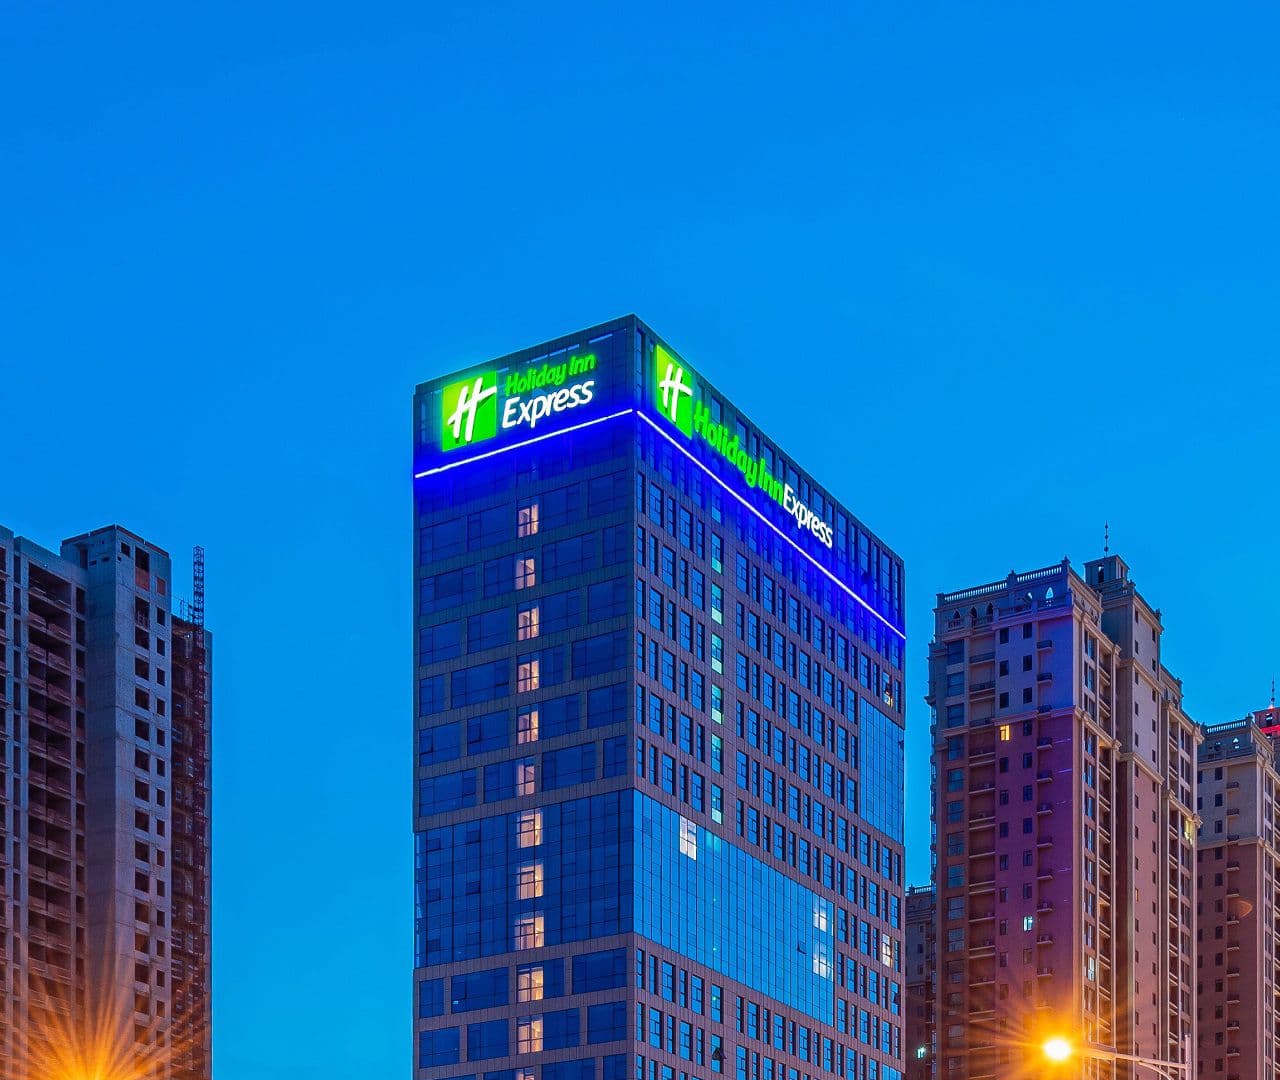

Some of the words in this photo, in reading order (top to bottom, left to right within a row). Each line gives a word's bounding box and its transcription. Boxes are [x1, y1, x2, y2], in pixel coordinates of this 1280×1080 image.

[505, 357, 567, 396] Holiday
[569, 351, 597, 378] Inn
[502, 378, 595, 430] Express
[694, 401, 759, 489] Holiday
[757, 456, 784, 507] Inn
[782, 482, 834, 549] Express
